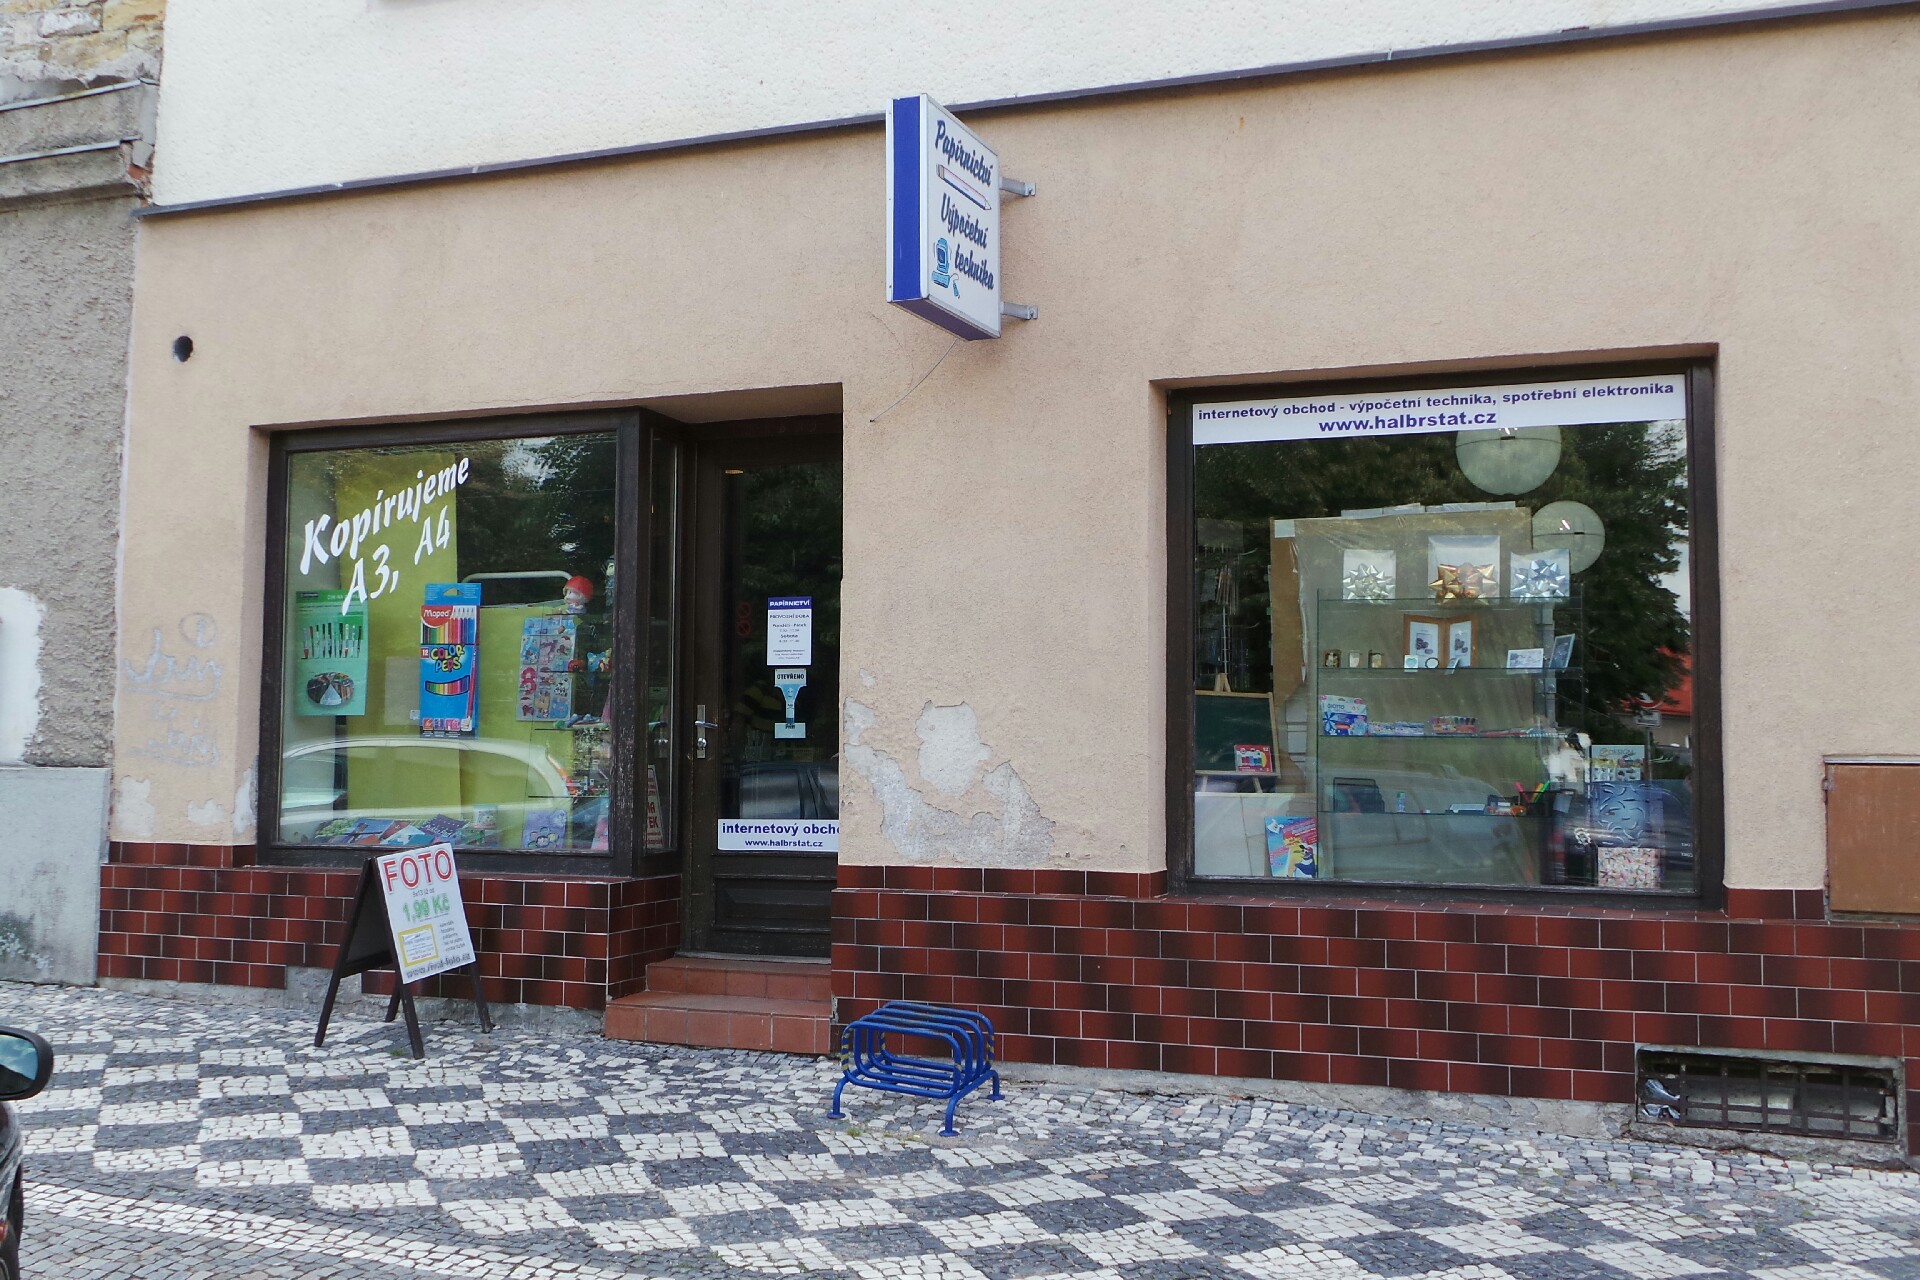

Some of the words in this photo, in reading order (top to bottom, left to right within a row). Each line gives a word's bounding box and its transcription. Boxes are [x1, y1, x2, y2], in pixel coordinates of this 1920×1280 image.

[934, 119, 994, 187] Papírnictví
[940, 192, 989, 249] Výpočetní
[954, 244, 994, 291] technika
[1198, 405, 1279, 420] internetový
[1283, 402, 1336, 415] obchod
[1349, 396, 1421, 413] výpočetní
[1426, 394, 1497, 407] technika,
[1502, 387, 1577, 405] spotřební
[1582, 383, 1674, 398] elektronika
[1318, 411, 1497, 433] www.halbrstat.cz
[299, 457, 470, 576] Kopírujeme
[341, 544, 400, 617] A3,
[413, 505, 451, 566] A4
[430, 645, 465, 660] COLOR
[722, 822, 798, 836] internetový
[803, 823, 840, 835] obch
[744, 839, 824, 848] www.halbrstat.cz
[382, 849, 453, 893] FOTO
